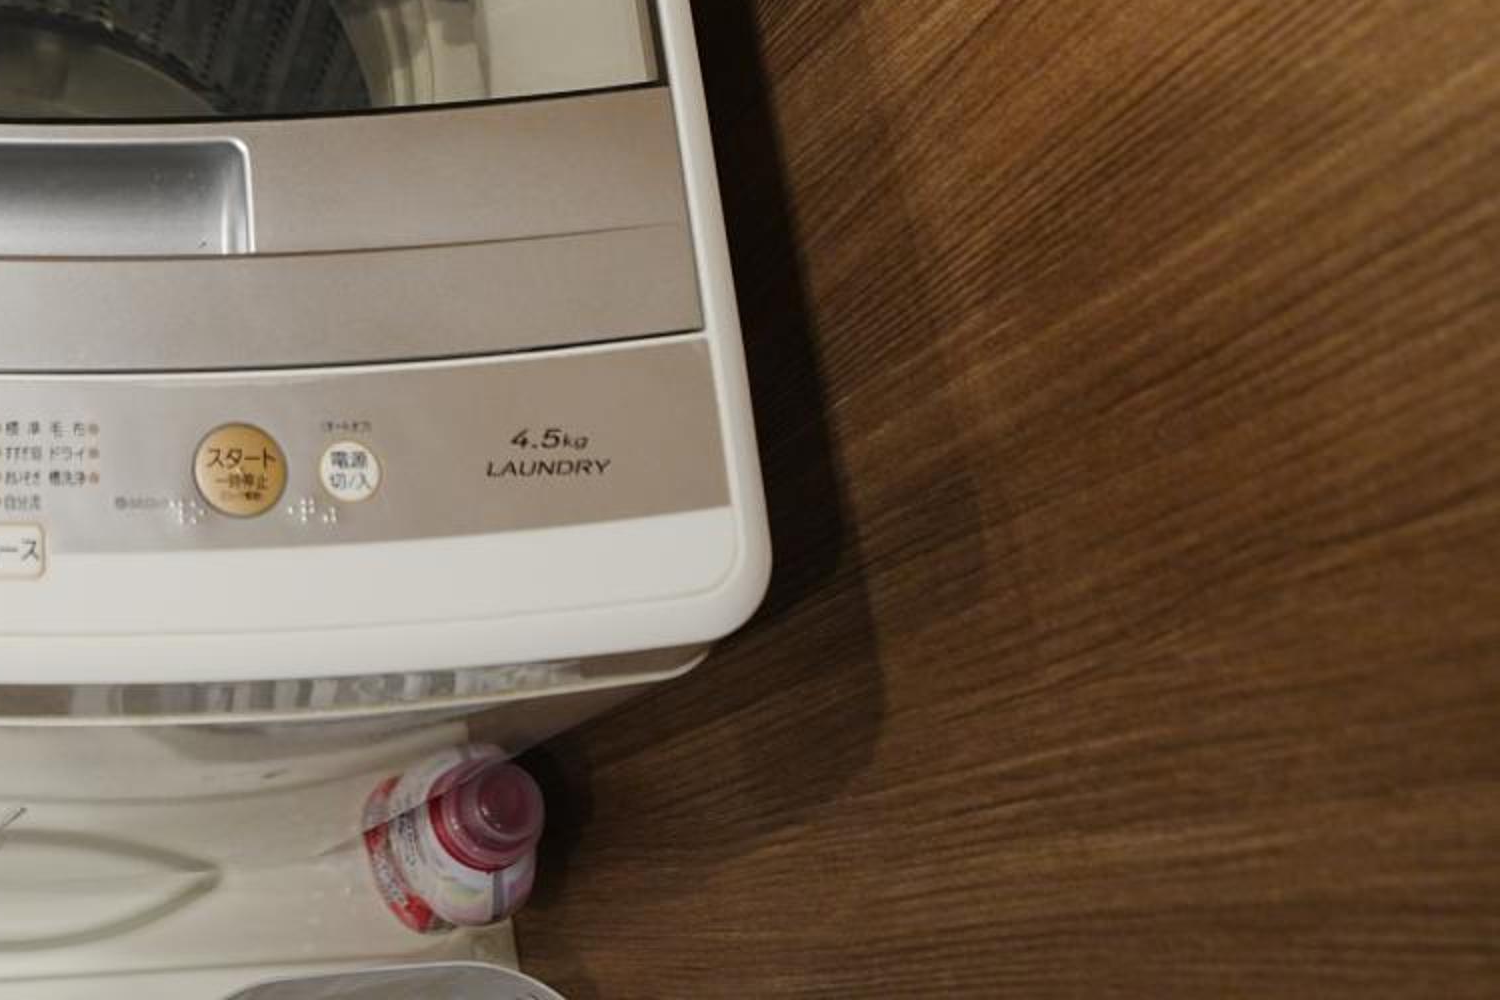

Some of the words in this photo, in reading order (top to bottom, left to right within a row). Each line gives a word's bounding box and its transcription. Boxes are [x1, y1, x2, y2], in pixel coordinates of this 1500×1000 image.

[510, 428, 589, 450] 4.5kg
[206, 447, 277, 469] スタート
[330, 450, 367, 469] 電源
[486, 459, 611, 478] LAUNDRY
[329, 471, 373, 490] 切/入
